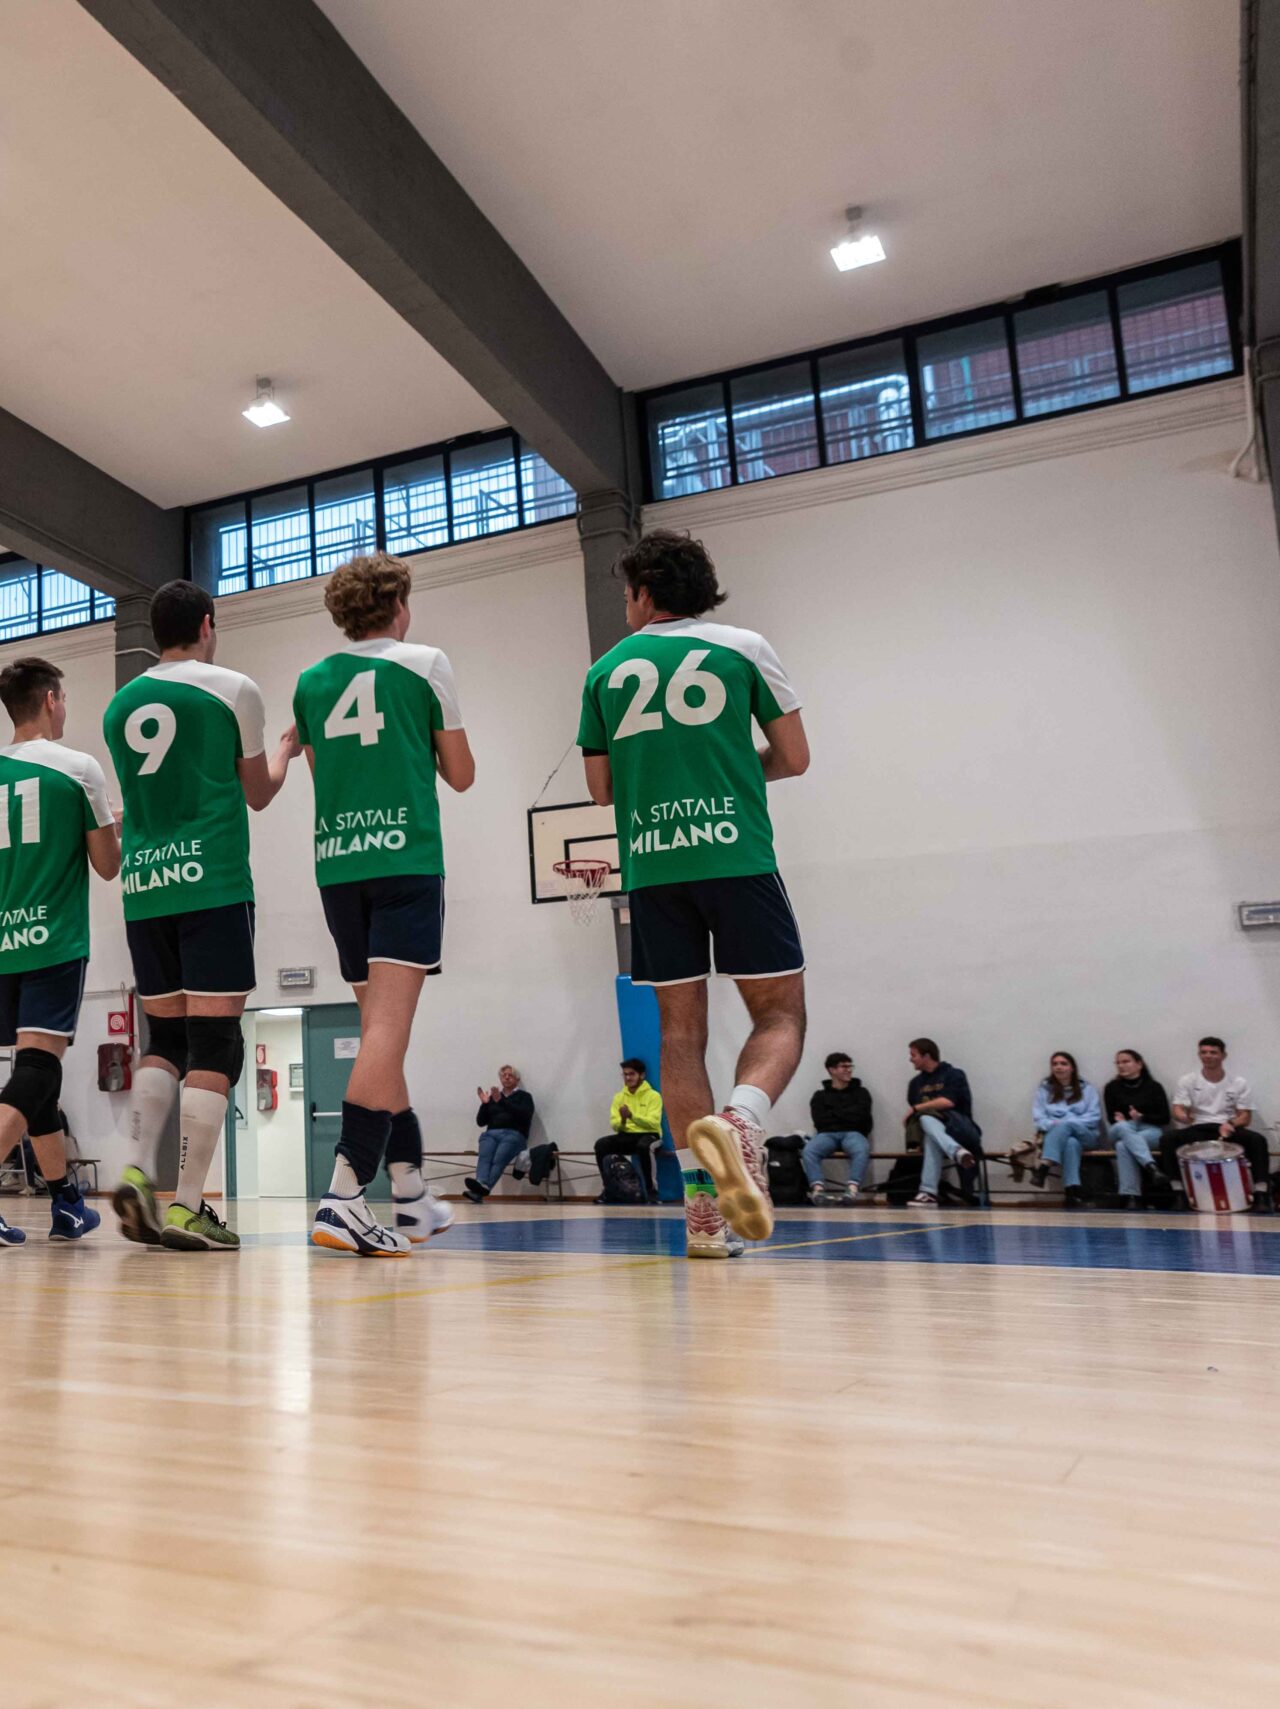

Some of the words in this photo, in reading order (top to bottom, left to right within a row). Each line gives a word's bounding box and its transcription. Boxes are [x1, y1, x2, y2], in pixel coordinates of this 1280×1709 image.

[324, 669, 385, 746] 4
[607, 649, 727, 740] 26
[124, 703, 177, 776] 9
[335, 807, 408, 831] STATALE
[650, 797, 736, 823] STATALE
[134, 840, 203, 866] STATALE
[316, 829, 407, 862] MILANO
[629, 821, 739, 858] MILANO
